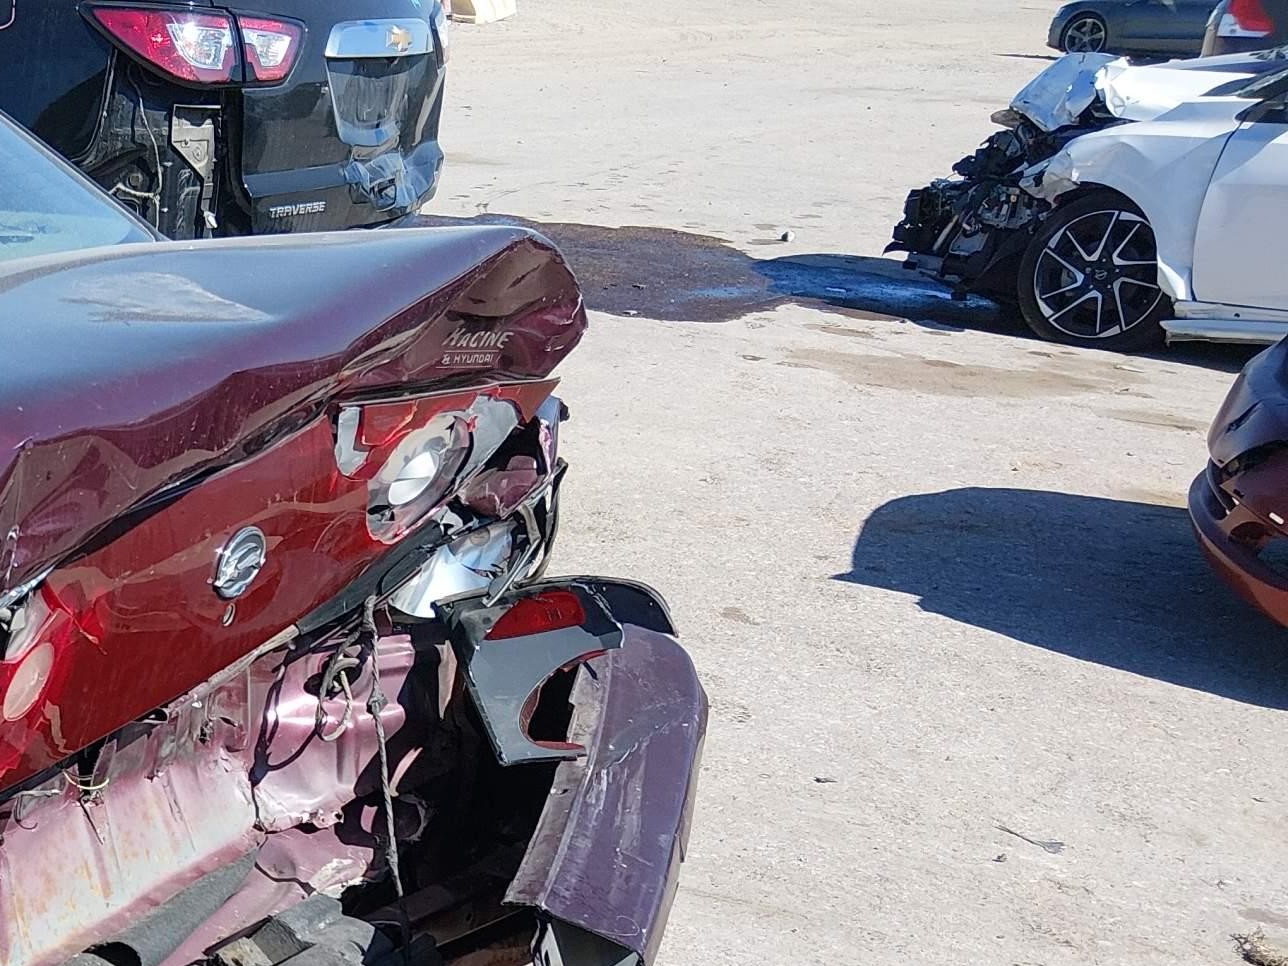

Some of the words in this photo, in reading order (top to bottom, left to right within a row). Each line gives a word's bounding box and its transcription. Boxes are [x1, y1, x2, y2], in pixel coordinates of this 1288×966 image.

[269, 201, 326, 218] TRAVERSE
[441, 353, 451, 365] &
[453, 353, 495, 364] HYUNDAI
